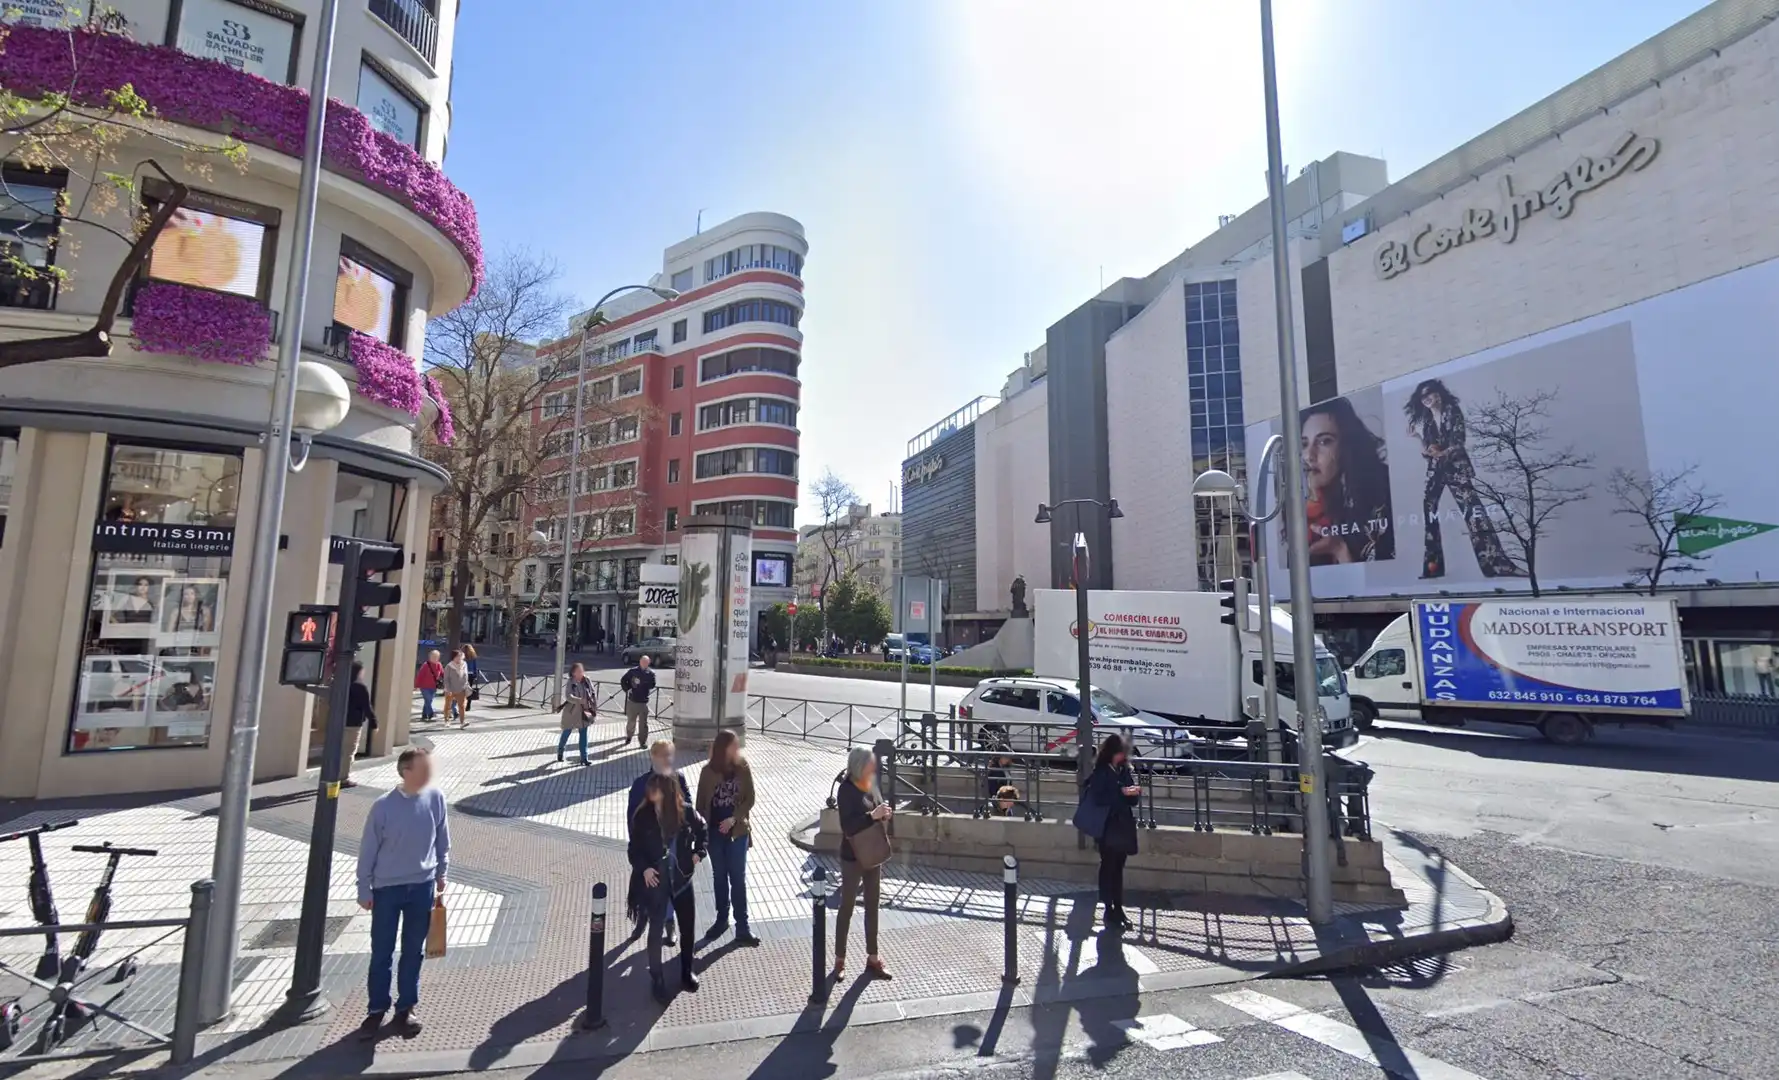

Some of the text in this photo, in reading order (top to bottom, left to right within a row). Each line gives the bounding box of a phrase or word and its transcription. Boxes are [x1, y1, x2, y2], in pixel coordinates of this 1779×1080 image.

[206, 31, 265, 56] SALVADOR
[205, 39, 263, 64] BACHILLER
[1373, 240, 1410, 280] El
[1411, 208, 1497, 265] Corte
[96, 524, 232, 541] intimissimi
[1320, 523, 1361, 538] CREA
[1367, 517, 1389, 532] TU
[153, 540, 187, 549] Italian
[1103, 613, 1180, 625] COMERCIAL FERJU
[1499, 607, 1549, 616] Nacional
[1563, 607, 1645, 616] Internacional
[1108, 628, 1129, 636] HIPER
[1130, 629, 1143, 637] DEL
[1145, 630, 1183, 640] EMBALAJE
[1482, 622, 1668, 637] MADSOLTRANSPORT
[1425, 603, 1457, 701] MUDANZAS
[1088, 656, 1172, 669] ww.hiperembalaje.com
[1102, 663, 1112, 671] 40
[1154, 668, 1164, 676] 27
[1488, 690, 1511, 699] 632
[1514, 691, 1537, 701] 845
[1540, 692, 1564, 702] 910
[1575, 693, 1600, 703] 634
[1603, 694, 1628, 705] 878
[1632, 695, 1658, 706] 764
